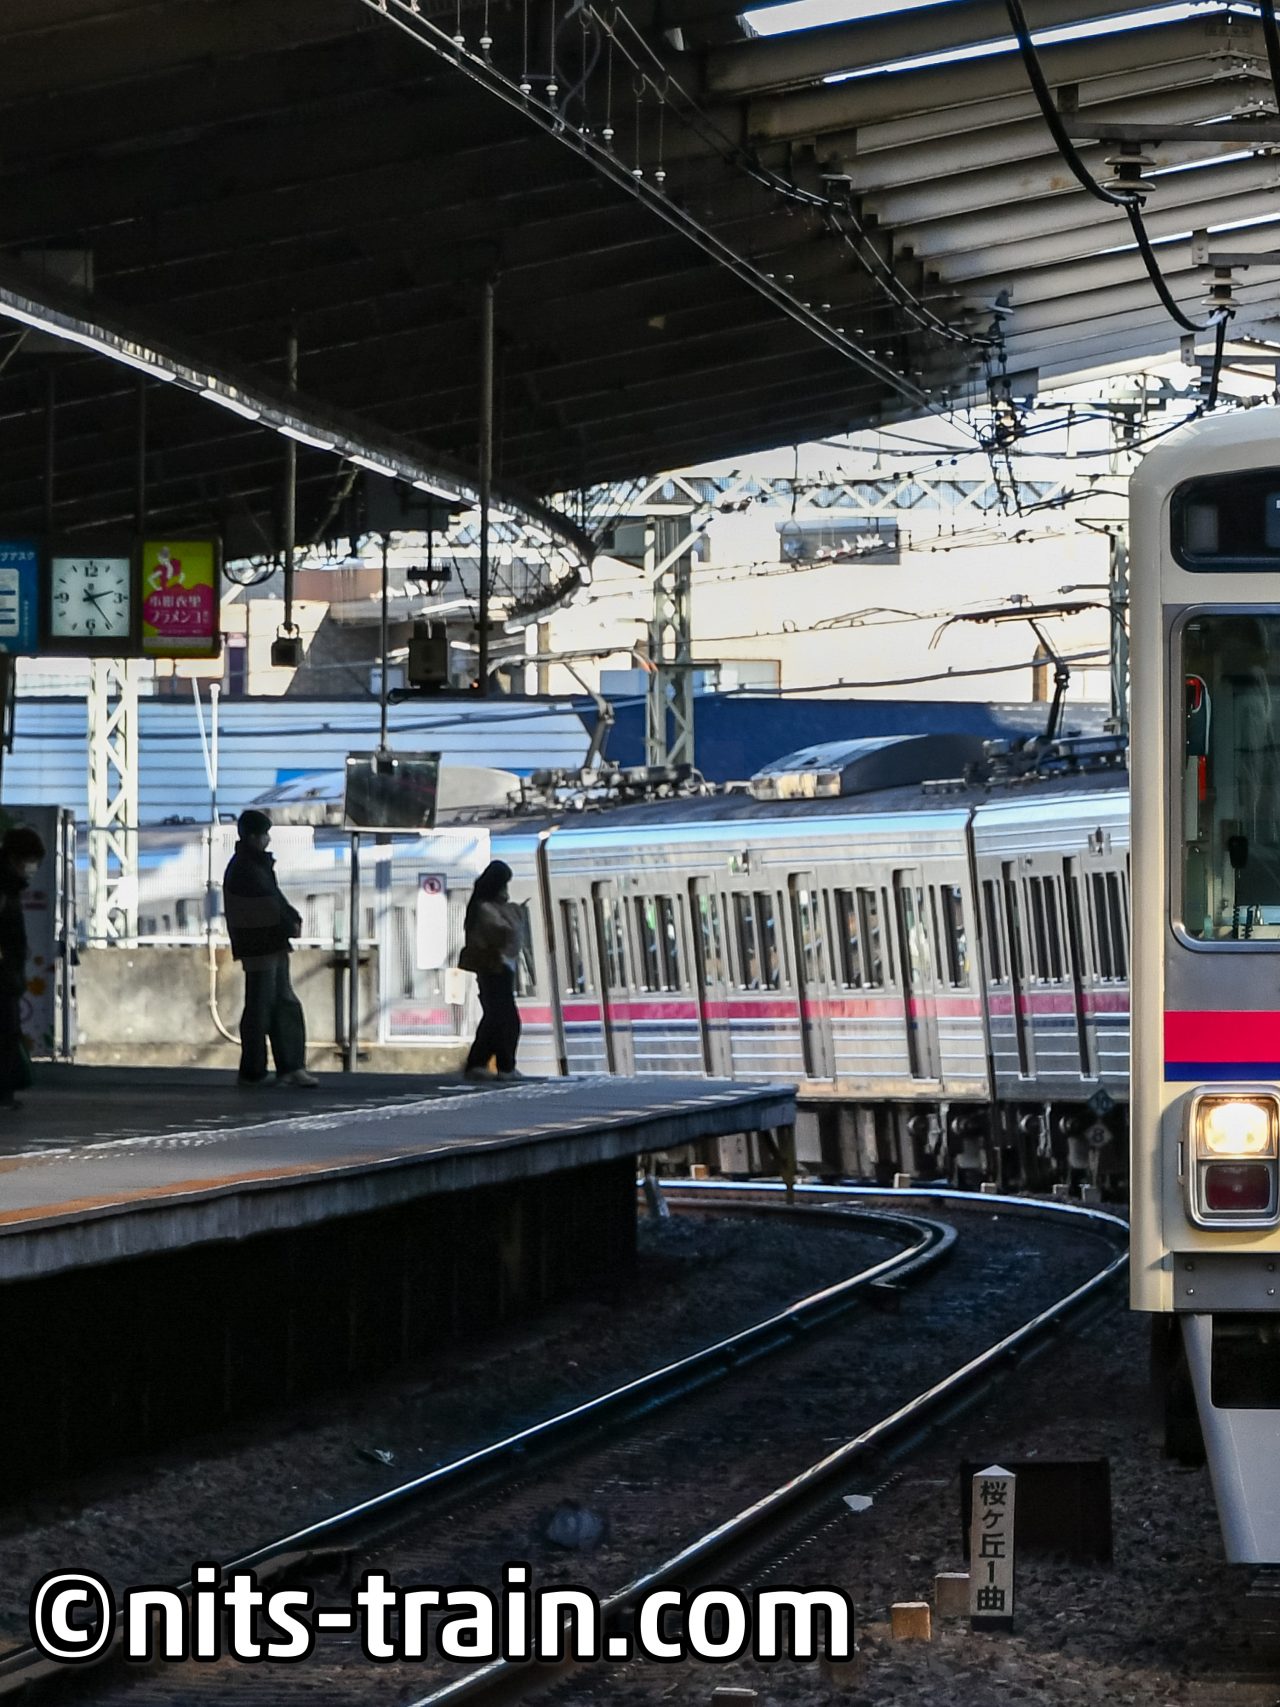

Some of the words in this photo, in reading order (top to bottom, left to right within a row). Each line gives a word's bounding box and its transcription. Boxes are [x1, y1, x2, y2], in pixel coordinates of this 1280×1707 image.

[84, 566, 99, 577] 12
[60, 592, 70, 603] 9
[113, 592, 123, 604] 3
[152, 609, 201, 624] フラメンコ
[86, 618, 96, 630] 6
